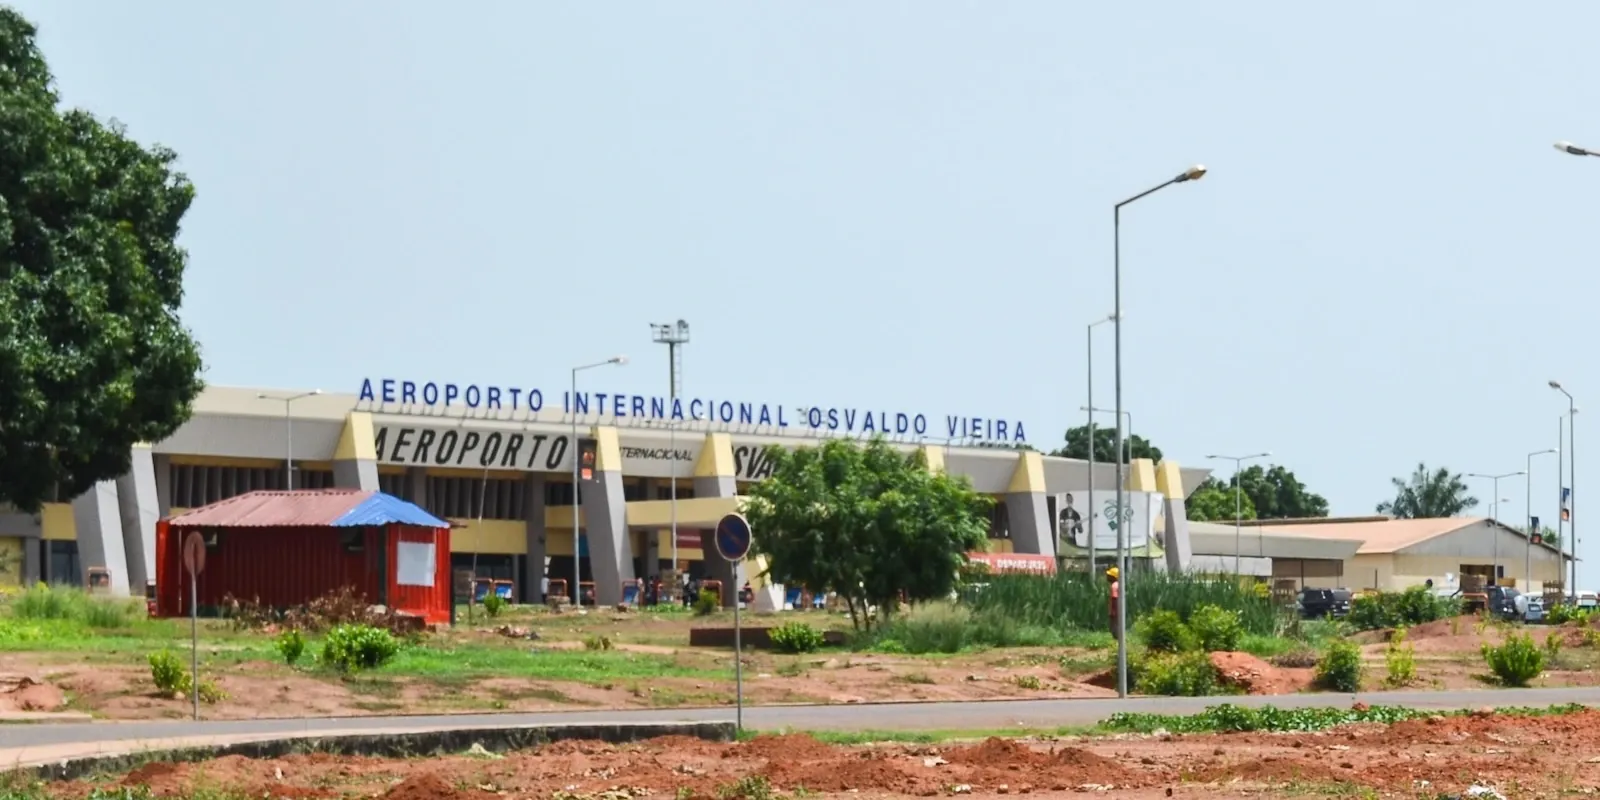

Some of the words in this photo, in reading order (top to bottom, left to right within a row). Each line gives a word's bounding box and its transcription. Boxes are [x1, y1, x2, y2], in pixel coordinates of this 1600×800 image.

[360, 378, 543, 411] AEROPORTO
[564, 391, 788, 427] INTERNACIONAL
[808, 407, 926, 434] OSVALDO
[947, 414, 1026, 441] VIEIRA
[375, 427, 569, 471] AEROPORTO
